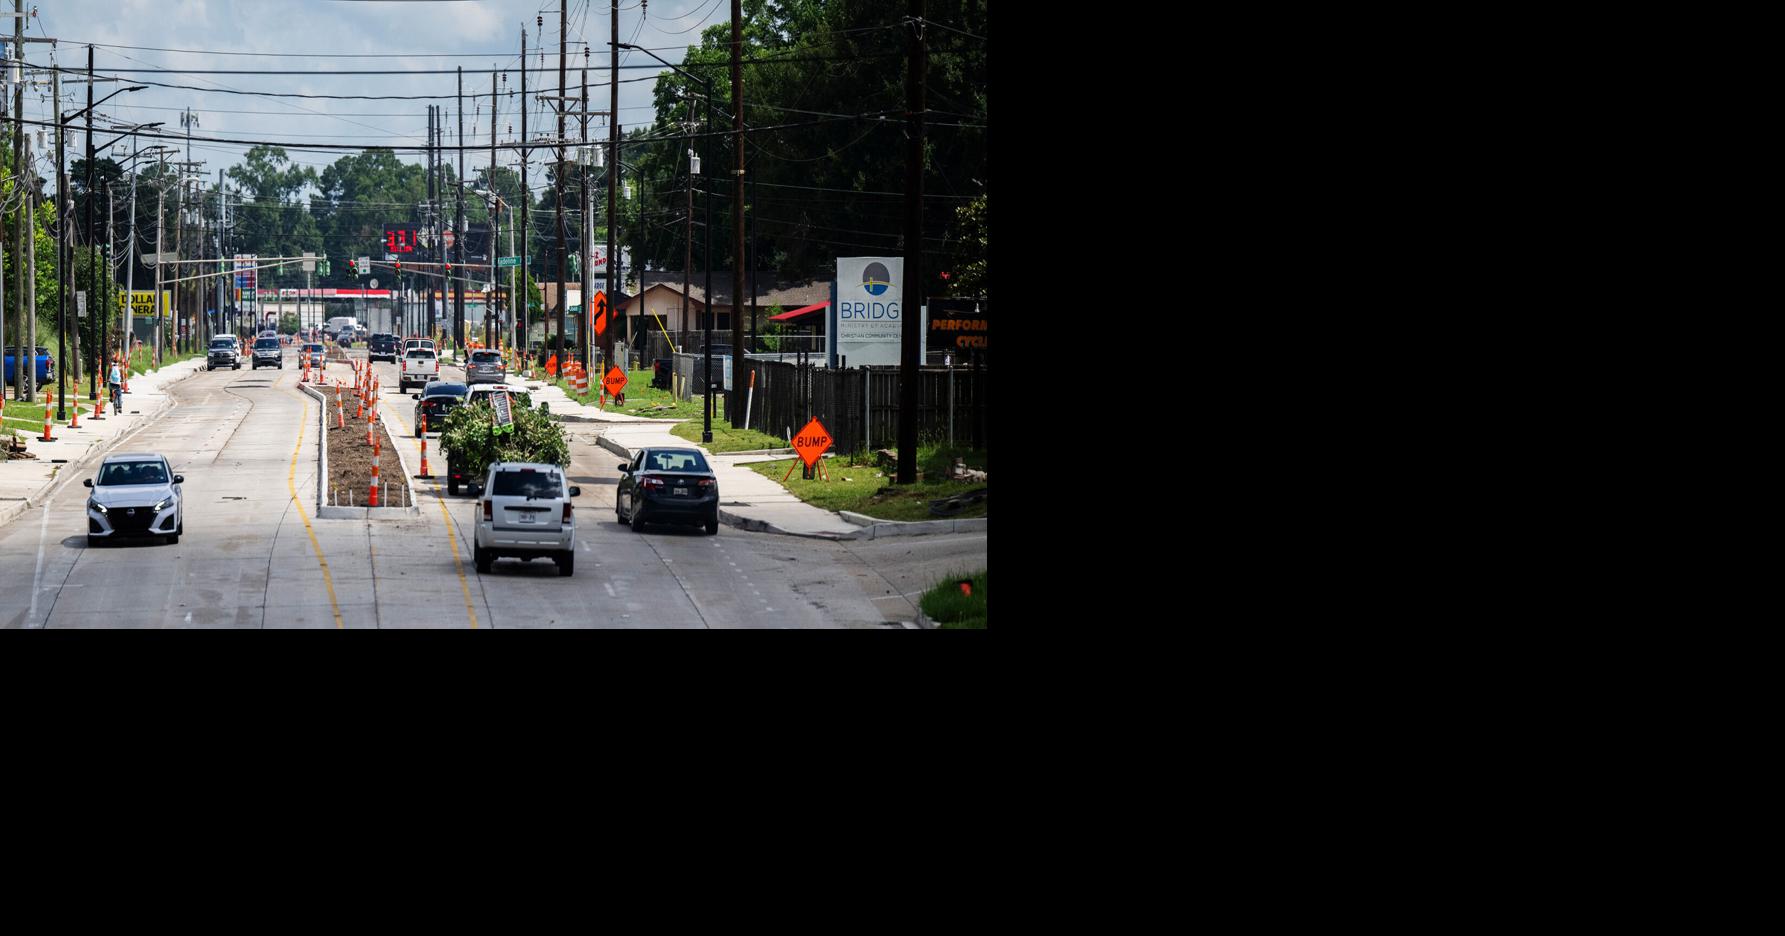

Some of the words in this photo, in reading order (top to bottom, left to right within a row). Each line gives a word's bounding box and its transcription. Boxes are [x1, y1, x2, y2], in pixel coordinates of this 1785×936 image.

[121, 294, 155, 304] DOLLA
[119, 304, 155, 314] GNERA
[841, 302, 899, 320] BRIDG
[606, 377, 625, 385] BUMP
[797, 436, 828, 447] BUMP
